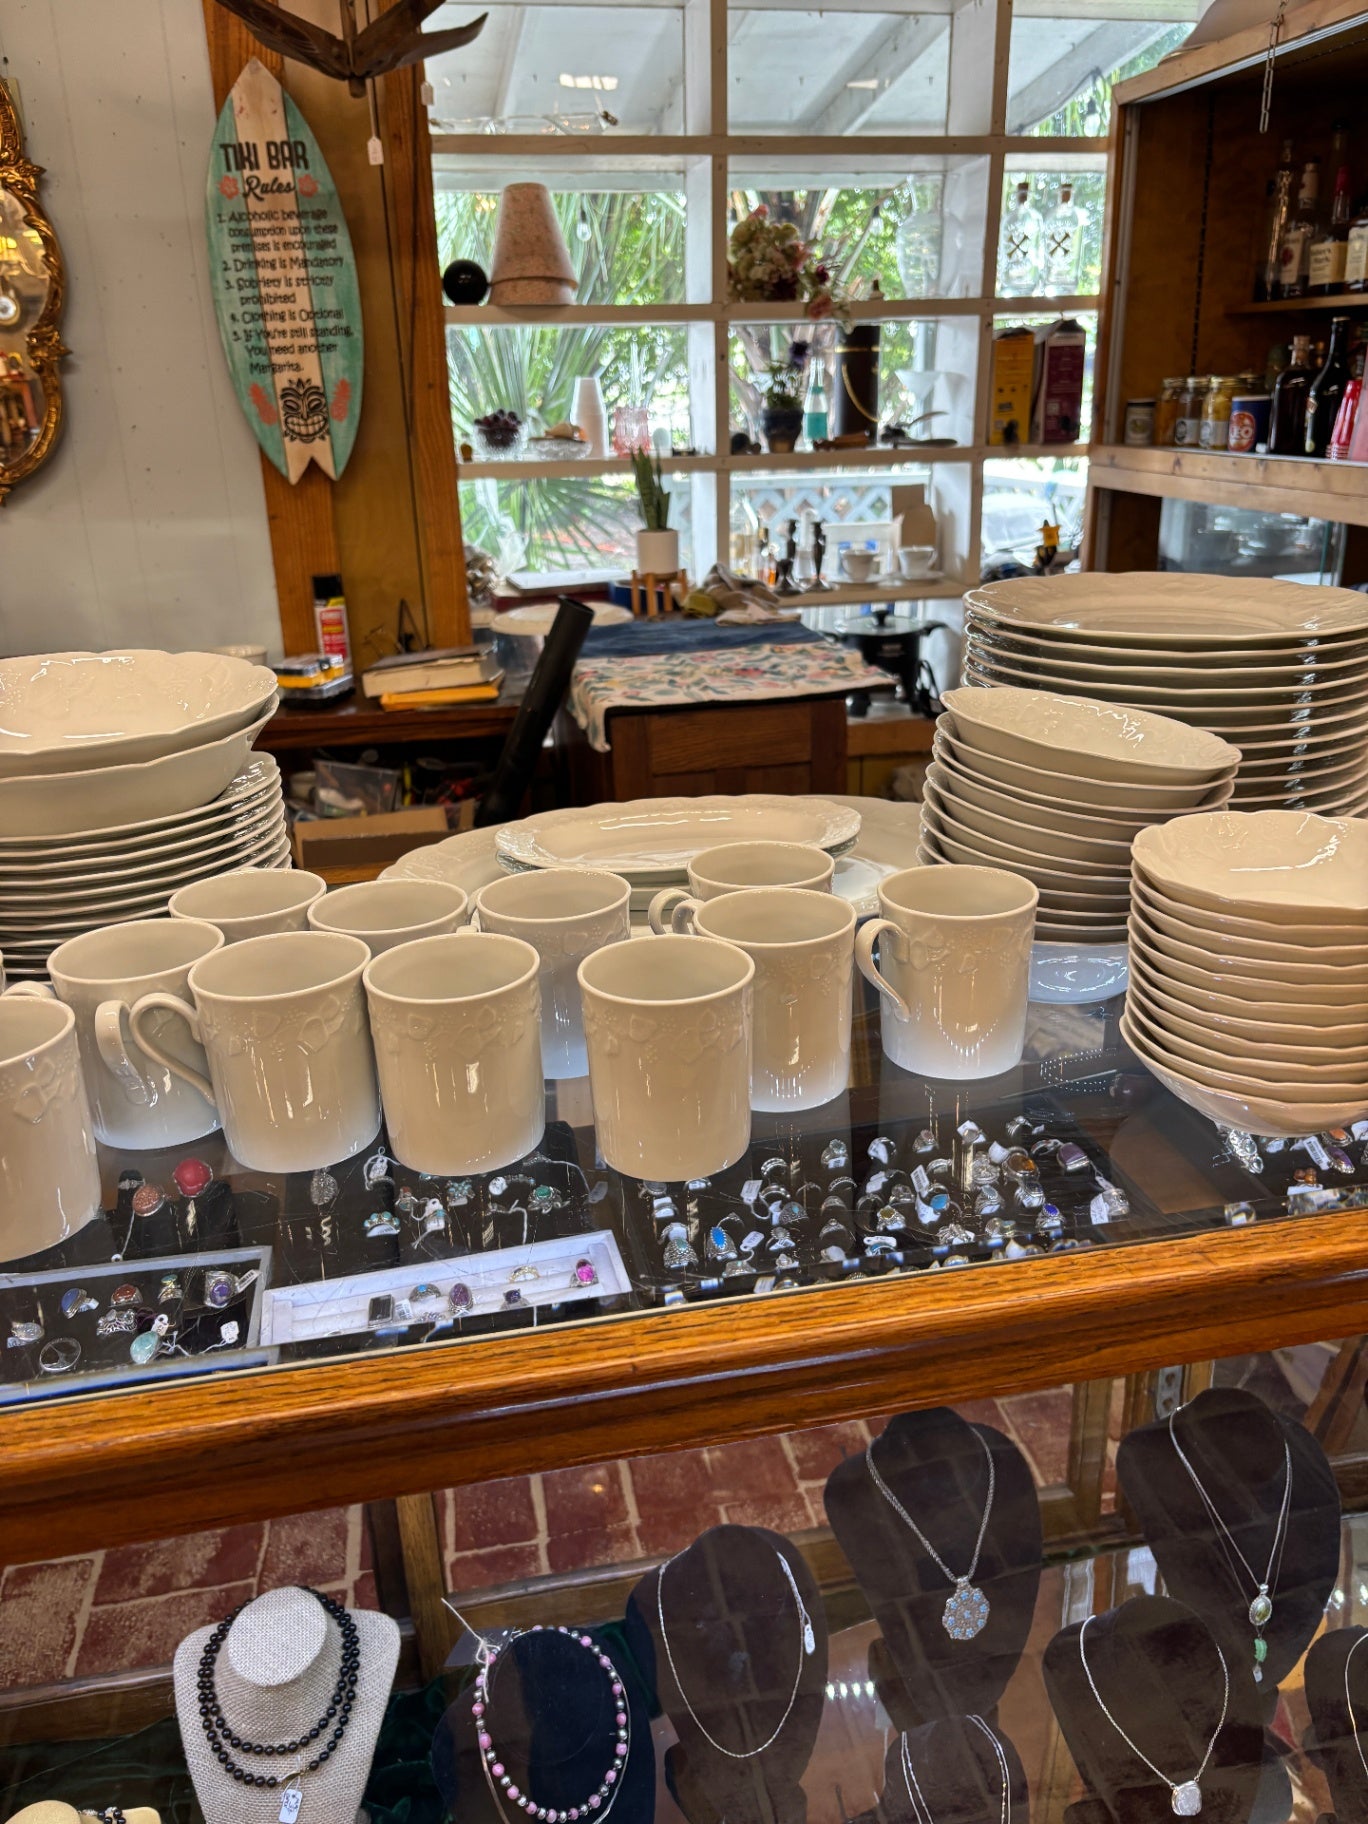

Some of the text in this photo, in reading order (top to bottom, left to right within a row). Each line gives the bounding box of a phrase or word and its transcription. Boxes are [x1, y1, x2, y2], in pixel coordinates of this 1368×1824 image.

[219, 141, 309, 172] TIKI BAR
[242, 175, 296, 202] Rules
[228, 210, 279, 223] Alcoholic
[281, 208, 328, 221] beverage
[228, 226, 287, 238] consumption
[231, 239, 337, 253] premises is encouraged
[234, 257, 277, 272] Drinking
[279, 258, 287, 268] is
[289, 256, 344, 270] Mandatory
[236, 276, 282, 291] Sobriety
[285, 276, 293, 287] is
[240, 293, 297, 306] prohibited
[241, 310, 287, 324] Clothing
[289, 311, 297, 321] is
[299, 308, 344, 322] Optional
[288, 326, 307, 338] still
[245, 341, 338, 358] You need another
